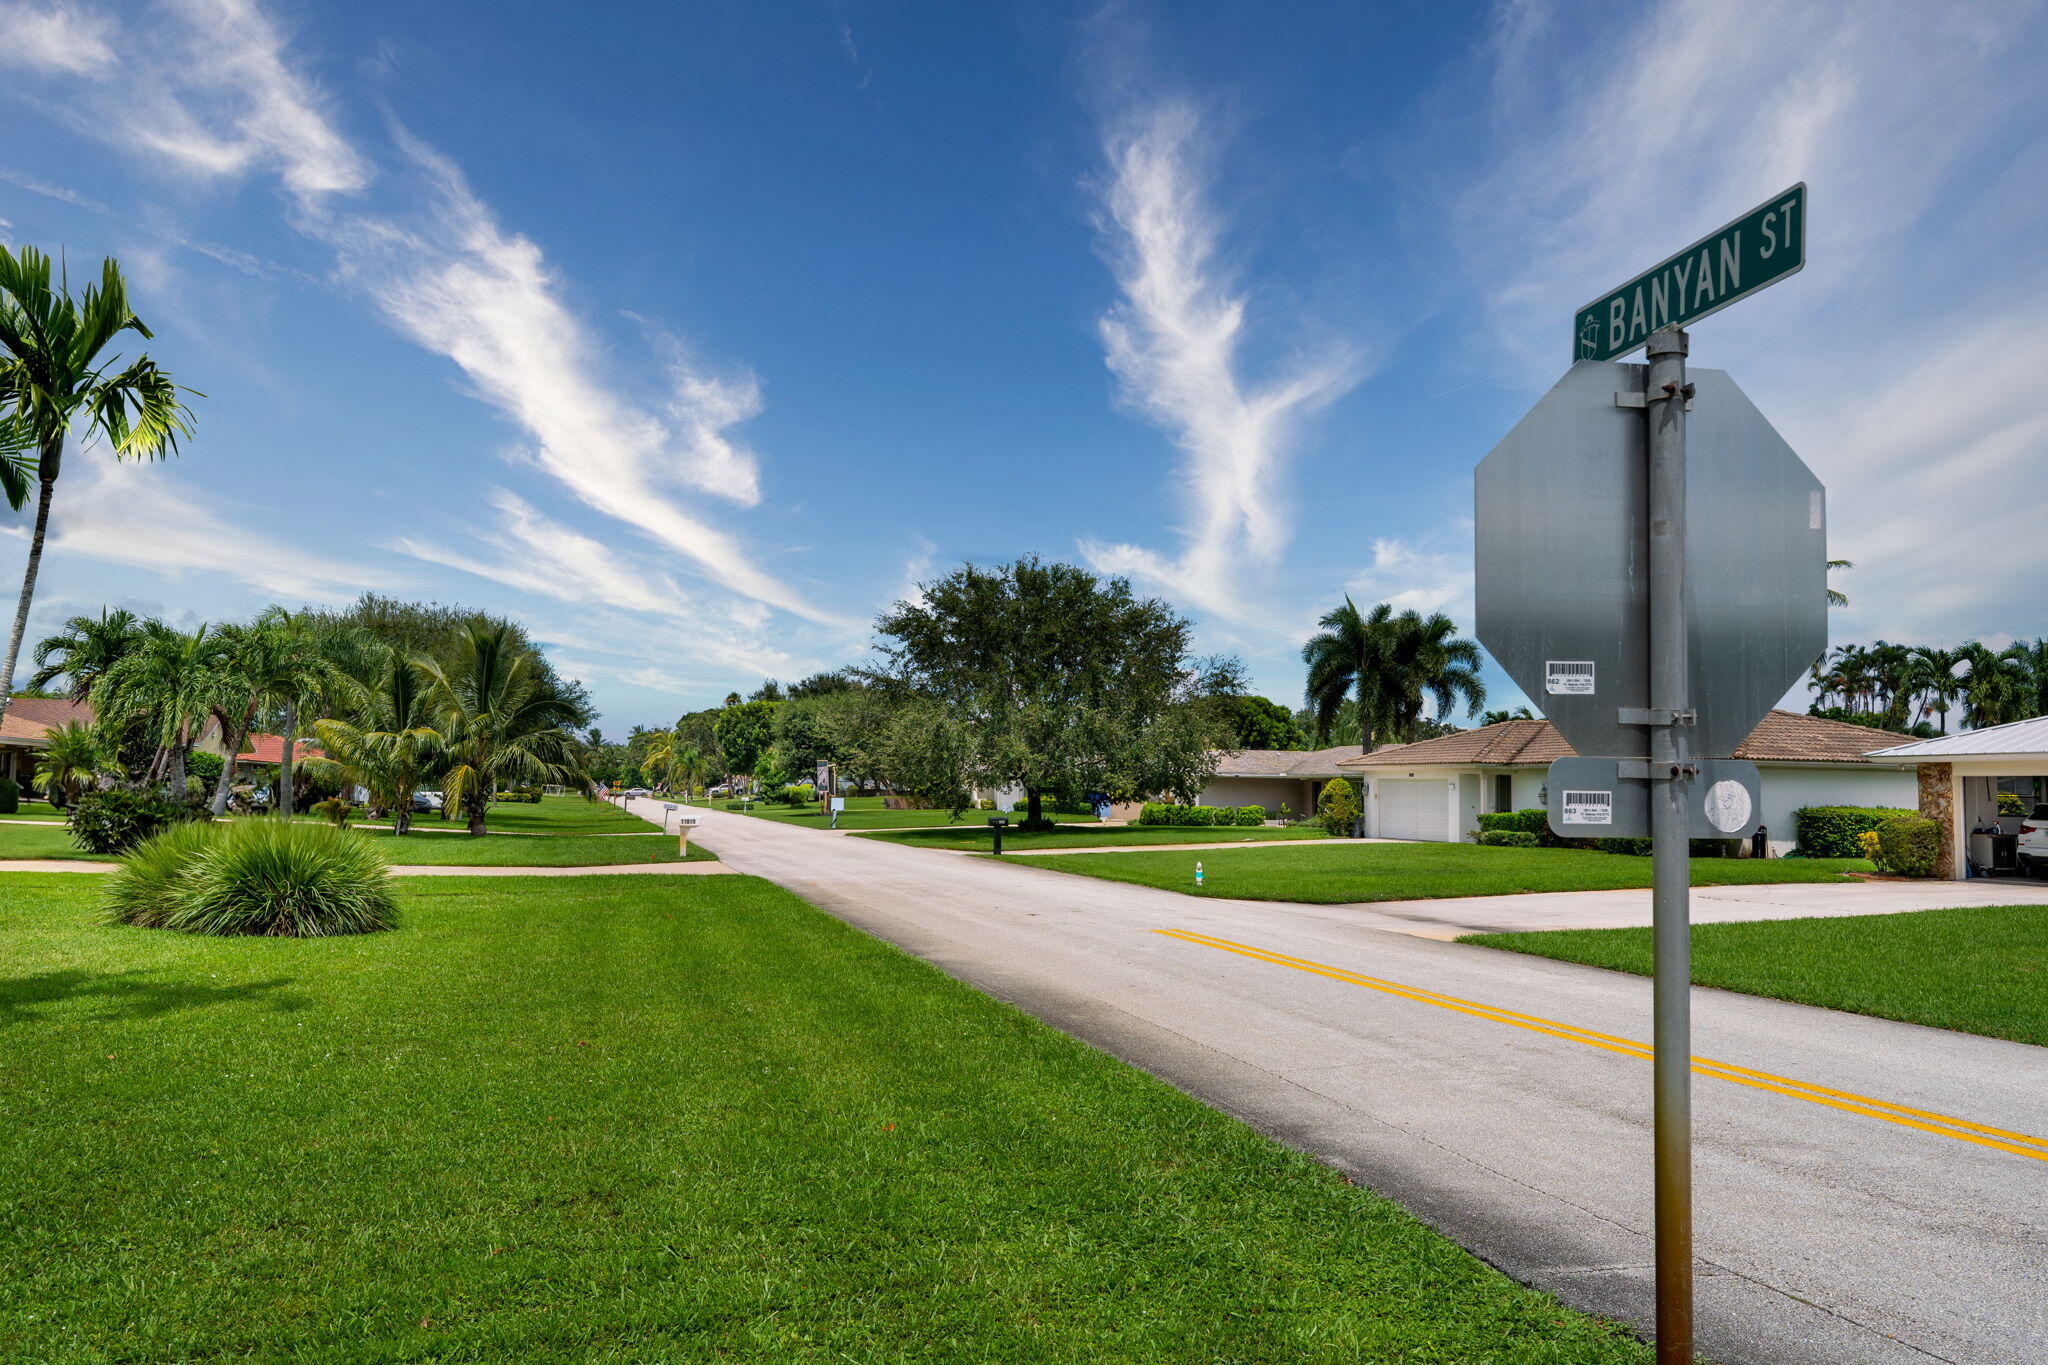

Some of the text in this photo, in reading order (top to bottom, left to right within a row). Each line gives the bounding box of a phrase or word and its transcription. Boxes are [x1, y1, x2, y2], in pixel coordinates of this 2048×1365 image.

[1609, 198, 1796, 351] BANYAN ST
[1564, 807, 1577, 815] 863
